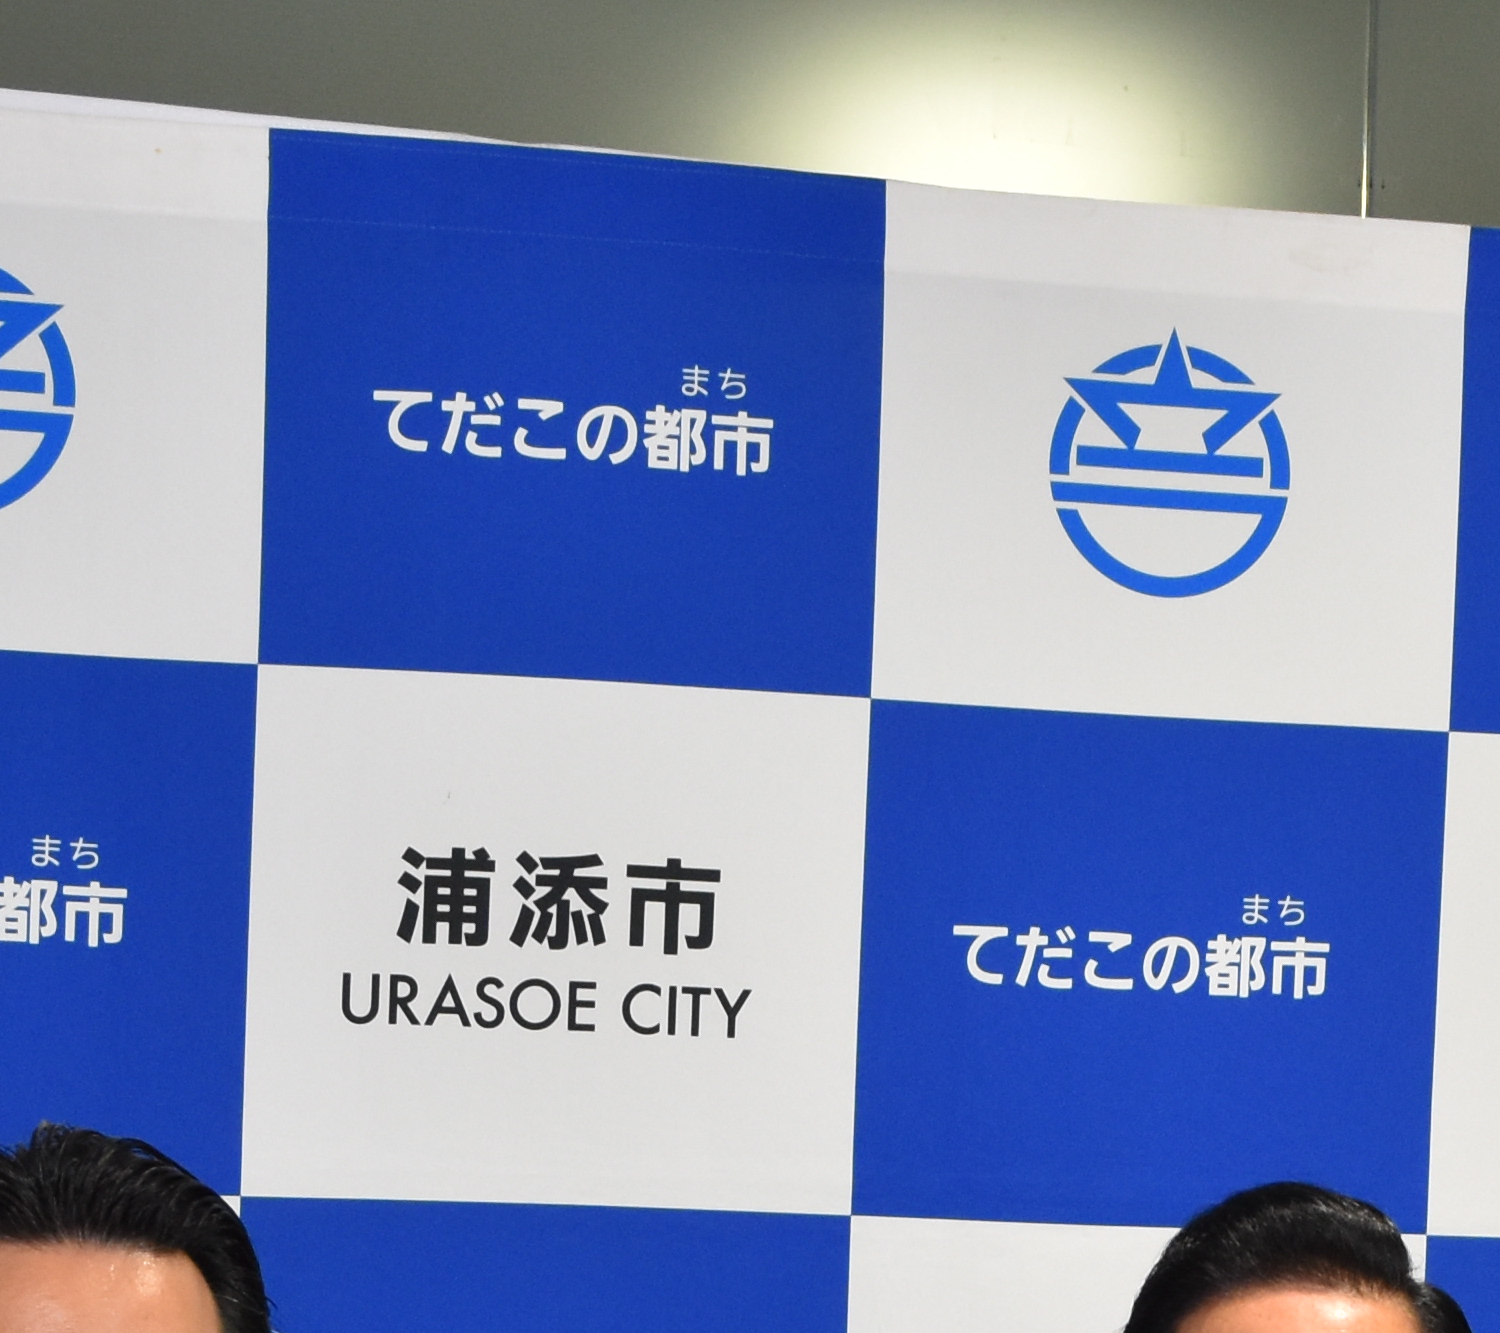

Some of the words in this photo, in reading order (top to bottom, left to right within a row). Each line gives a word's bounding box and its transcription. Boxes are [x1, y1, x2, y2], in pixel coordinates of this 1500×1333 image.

[682, 365, 746, 399] まち
[373, 390, 773, 475] てだこの都市
[32, 835, 98, 869] まち
[397, 848, 720, 955] 浦添市
[1243, 894, 1304, 925] まち
[953, 925, 1330, 999] てだこの都市
[342, 973, 596, 1031] URASOE
[622, 984, 751, 1038] CITY
